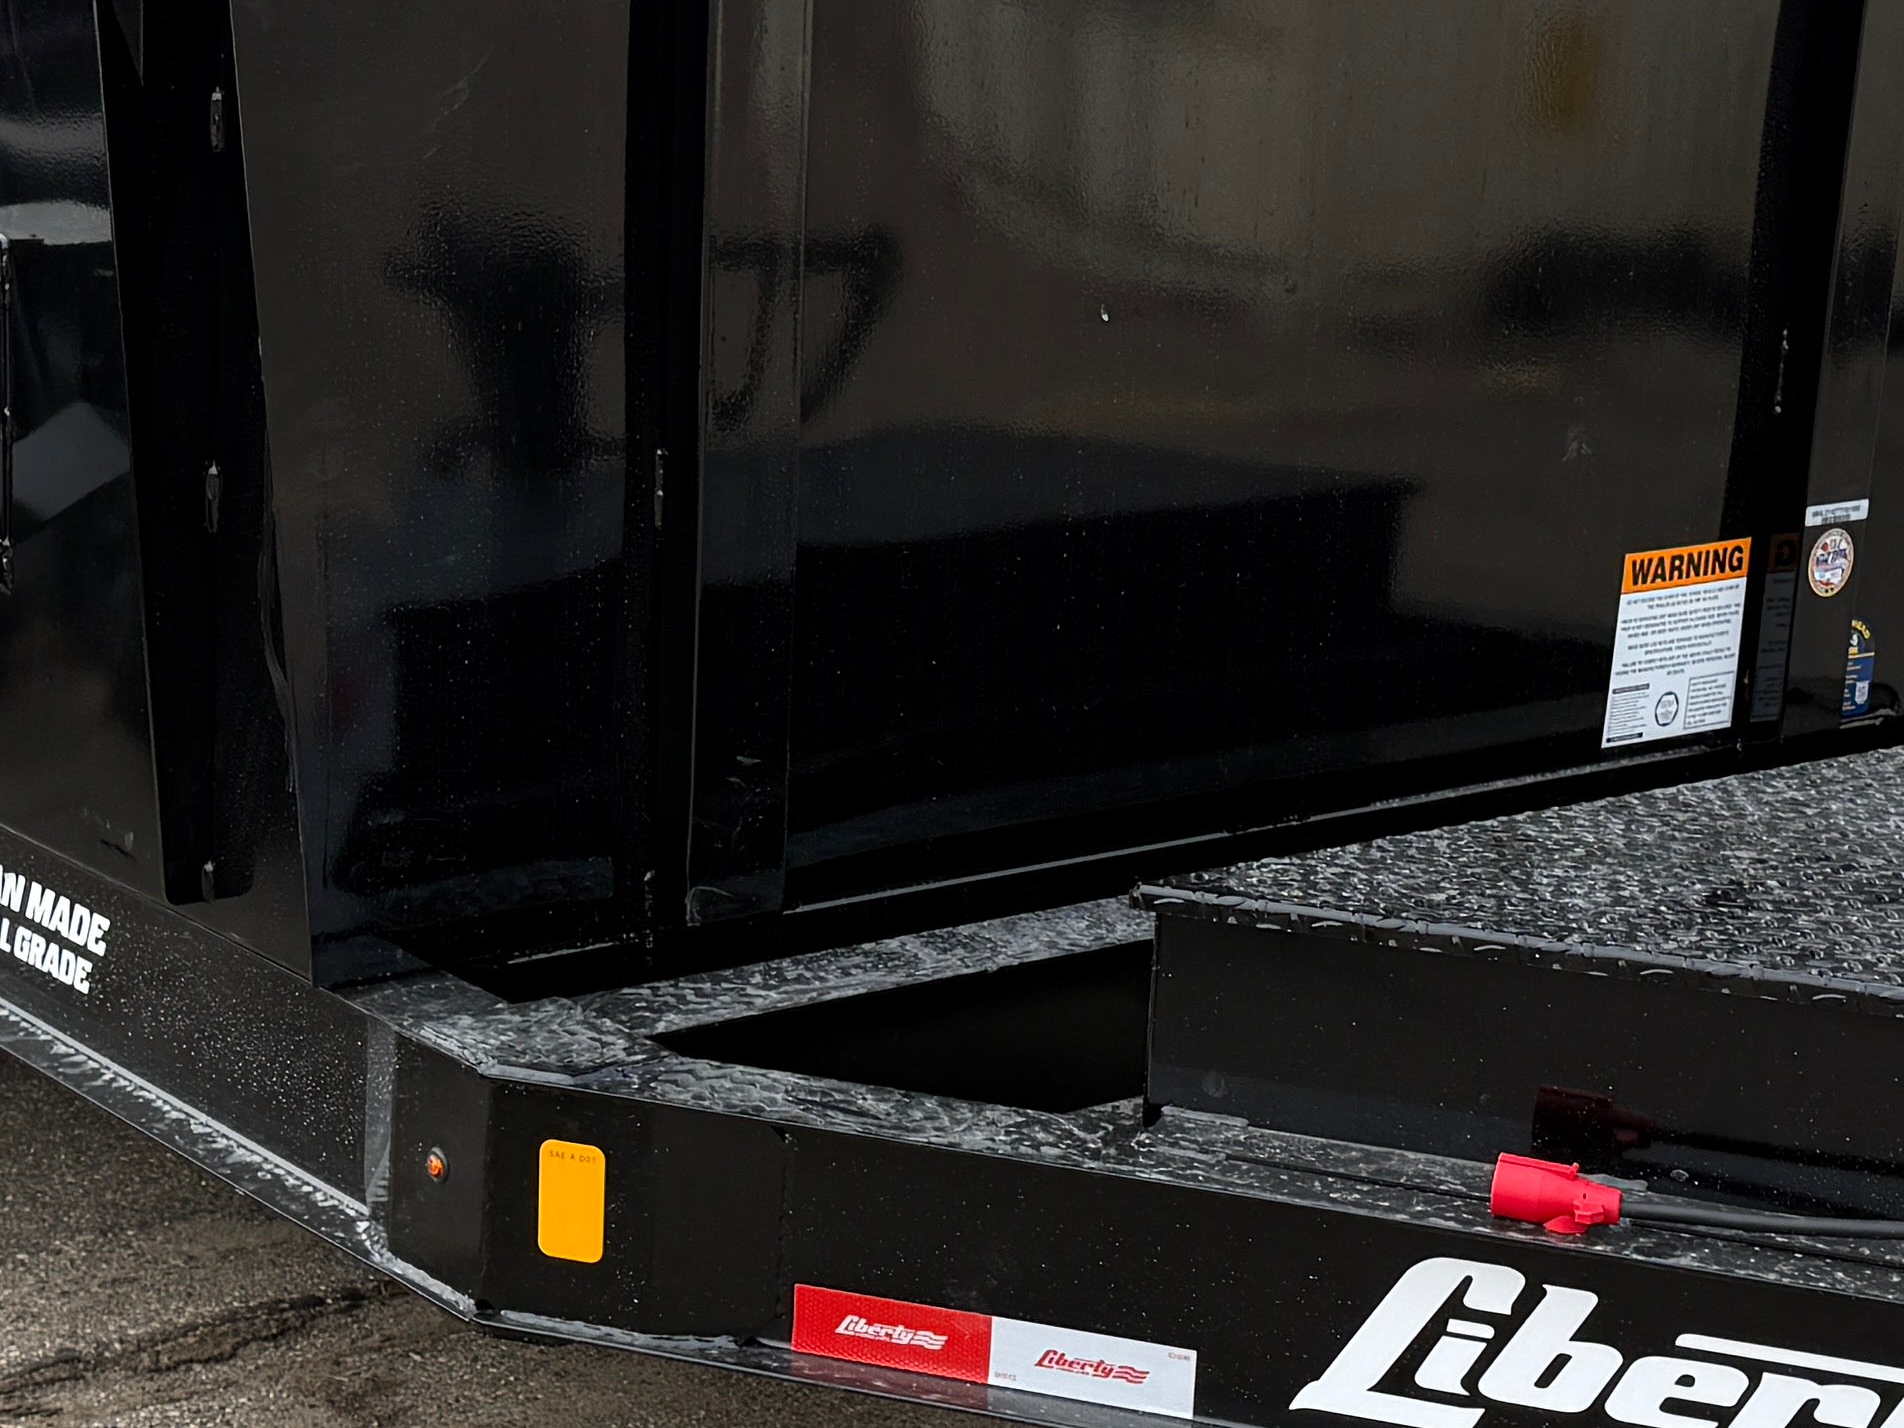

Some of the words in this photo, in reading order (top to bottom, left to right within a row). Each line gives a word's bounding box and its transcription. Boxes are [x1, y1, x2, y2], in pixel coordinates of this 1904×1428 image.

[1631, 545, 1744, 586] WARNING
[25, 882, 111, 957] MADE
[13, 926, 93, 995] GRADE
[834, 1314, 913, 1346] Liberty
[1034, 1349, 1116, 1378] Liberty
